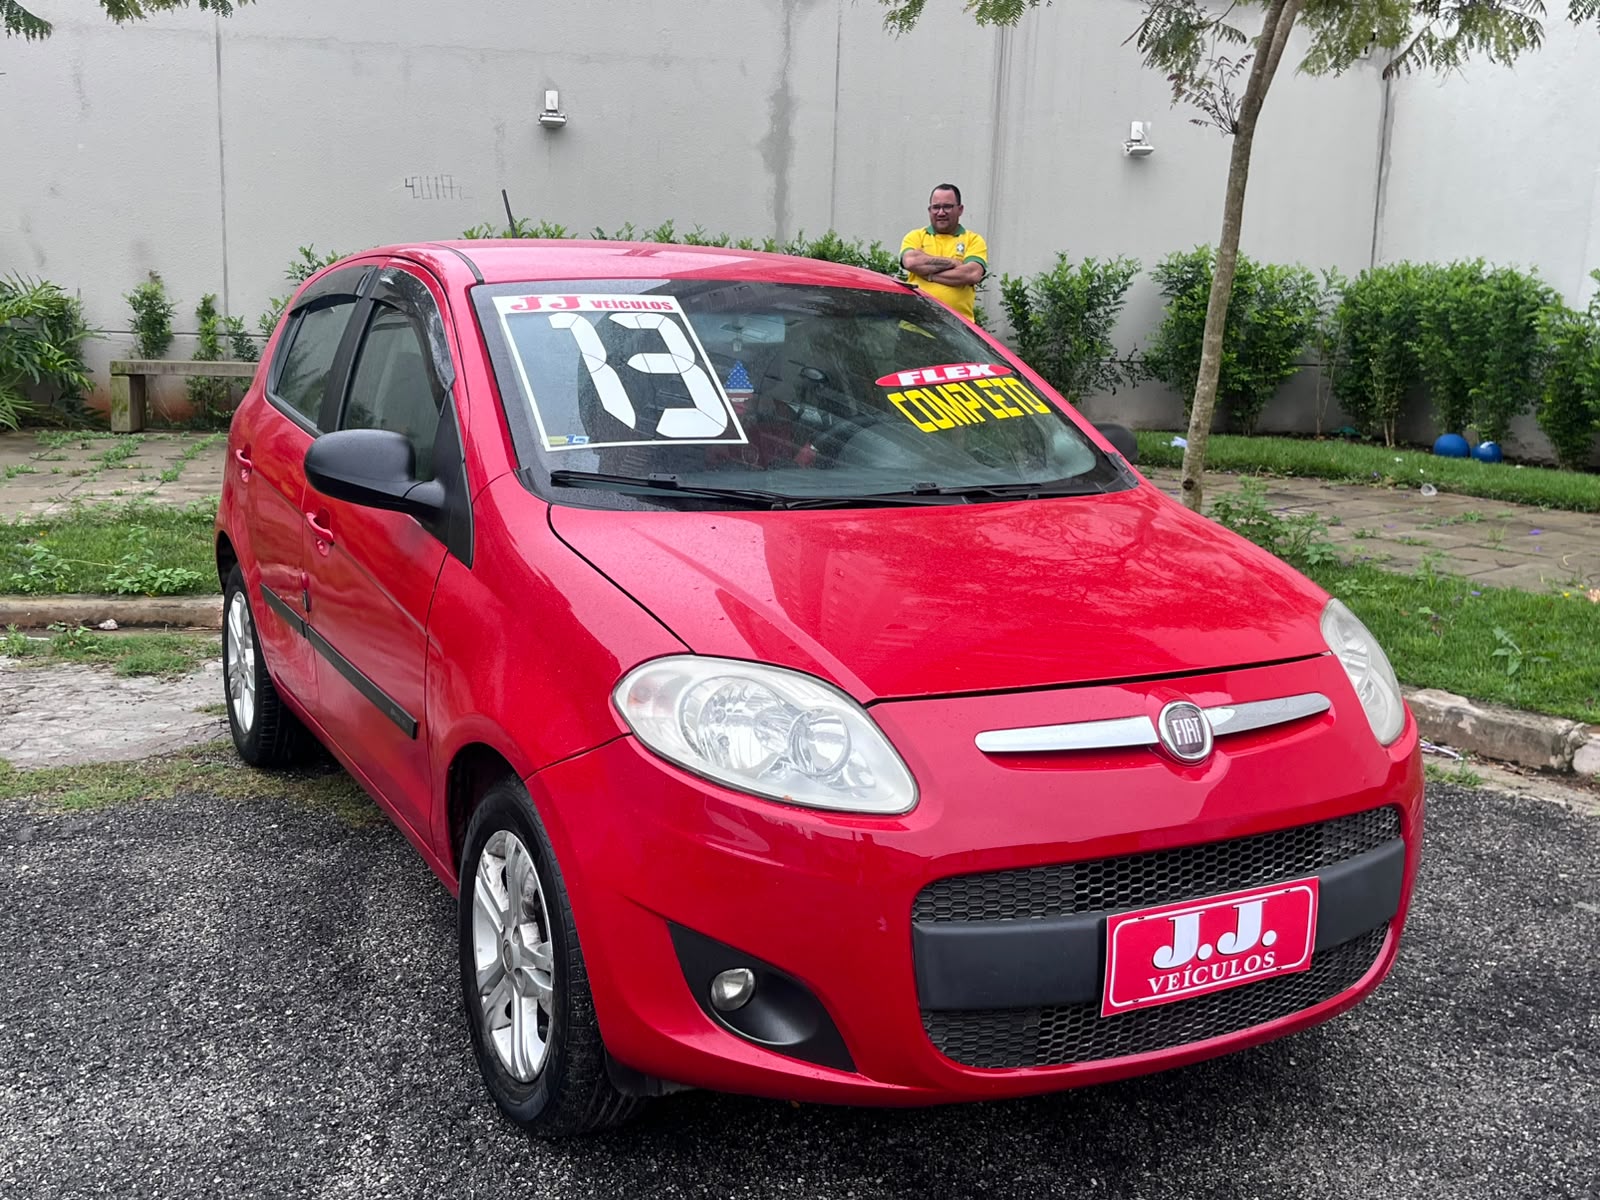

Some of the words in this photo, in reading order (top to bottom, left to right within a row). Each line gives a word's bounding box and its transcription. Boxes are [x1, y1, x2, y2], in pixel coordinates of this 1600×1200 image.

[548, 312, 728, 438] 13
[897, 364, 997, 386] FLEX
[887, 377, 1051, 433] COMPLETO
[1171, 717, 1202, 745] FIAT
[1152, 899, 1278, 970] J.J.
[1147, 951, 1276, 994] VEÍCULOS
